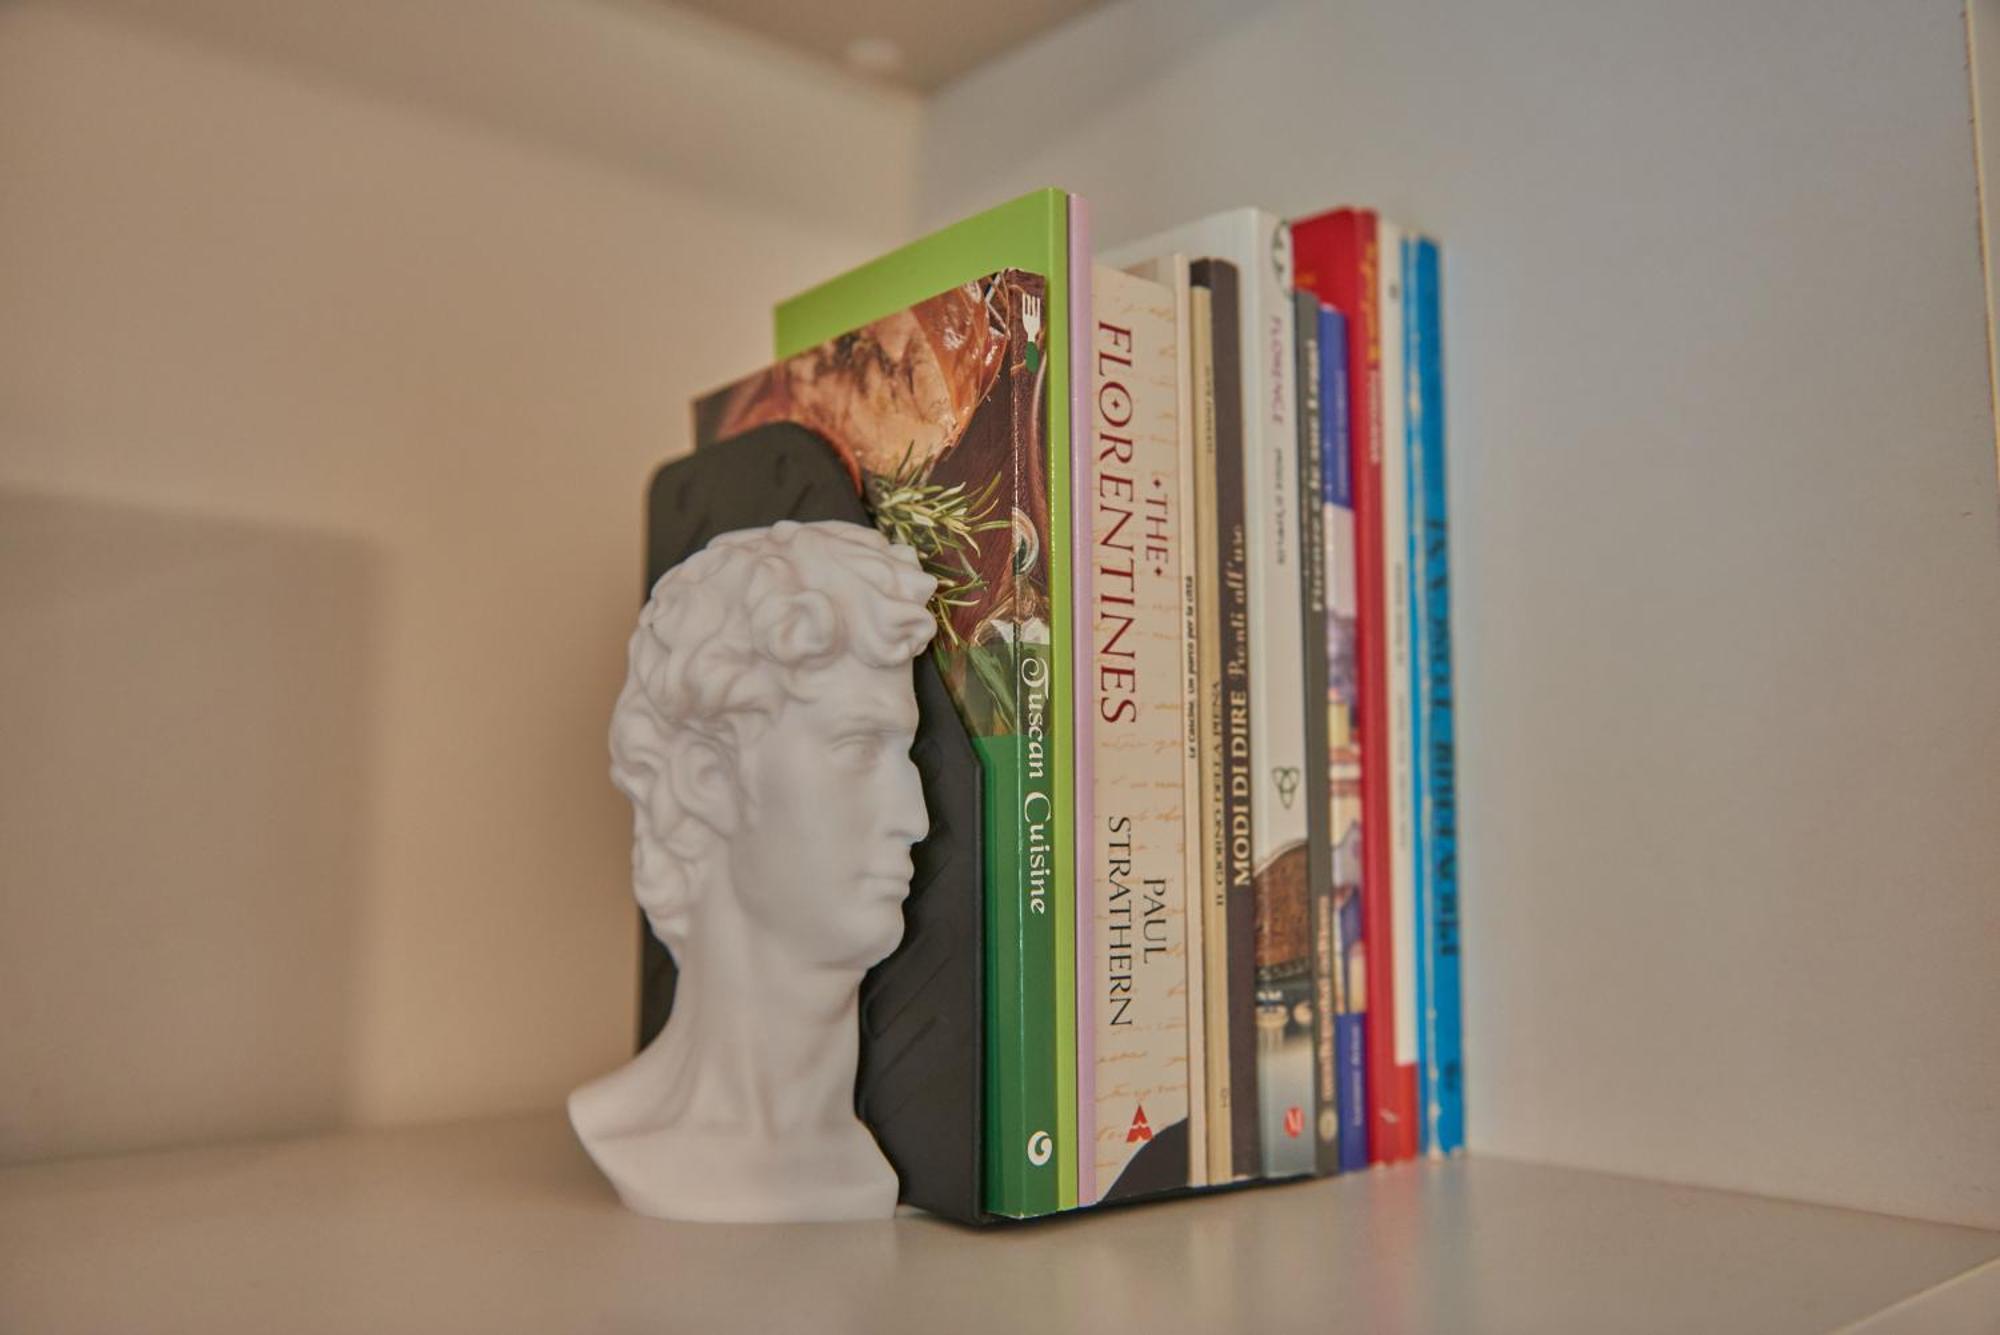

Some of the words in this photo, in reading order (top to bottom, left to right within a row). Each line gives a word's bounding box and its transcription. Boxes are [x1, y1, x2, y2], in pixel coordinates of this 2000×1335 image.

[1099, 320, 1136, 724] FLORENTINES
[1146, 493, 1168, 564] THE
[1226, 523, 1245, 605] all'uso
[1186, 619, 1196, 639] per
[1186, 641, 1197, 675] parco
[1227, 611, 1246, 676] Pronti
[1021, 657, 1049, 779] Tuscan
[1230, 689, 1249, 757] DIRE
[1232, 765, 1249, 798] DI
[1024, 791, 1052, 915] Cuisine
[1232, 803, 1251, 886] MODI
[1108, 816, 1133, 1026] STRATHERN
[1143, 878, 1167, 965] PAUL
